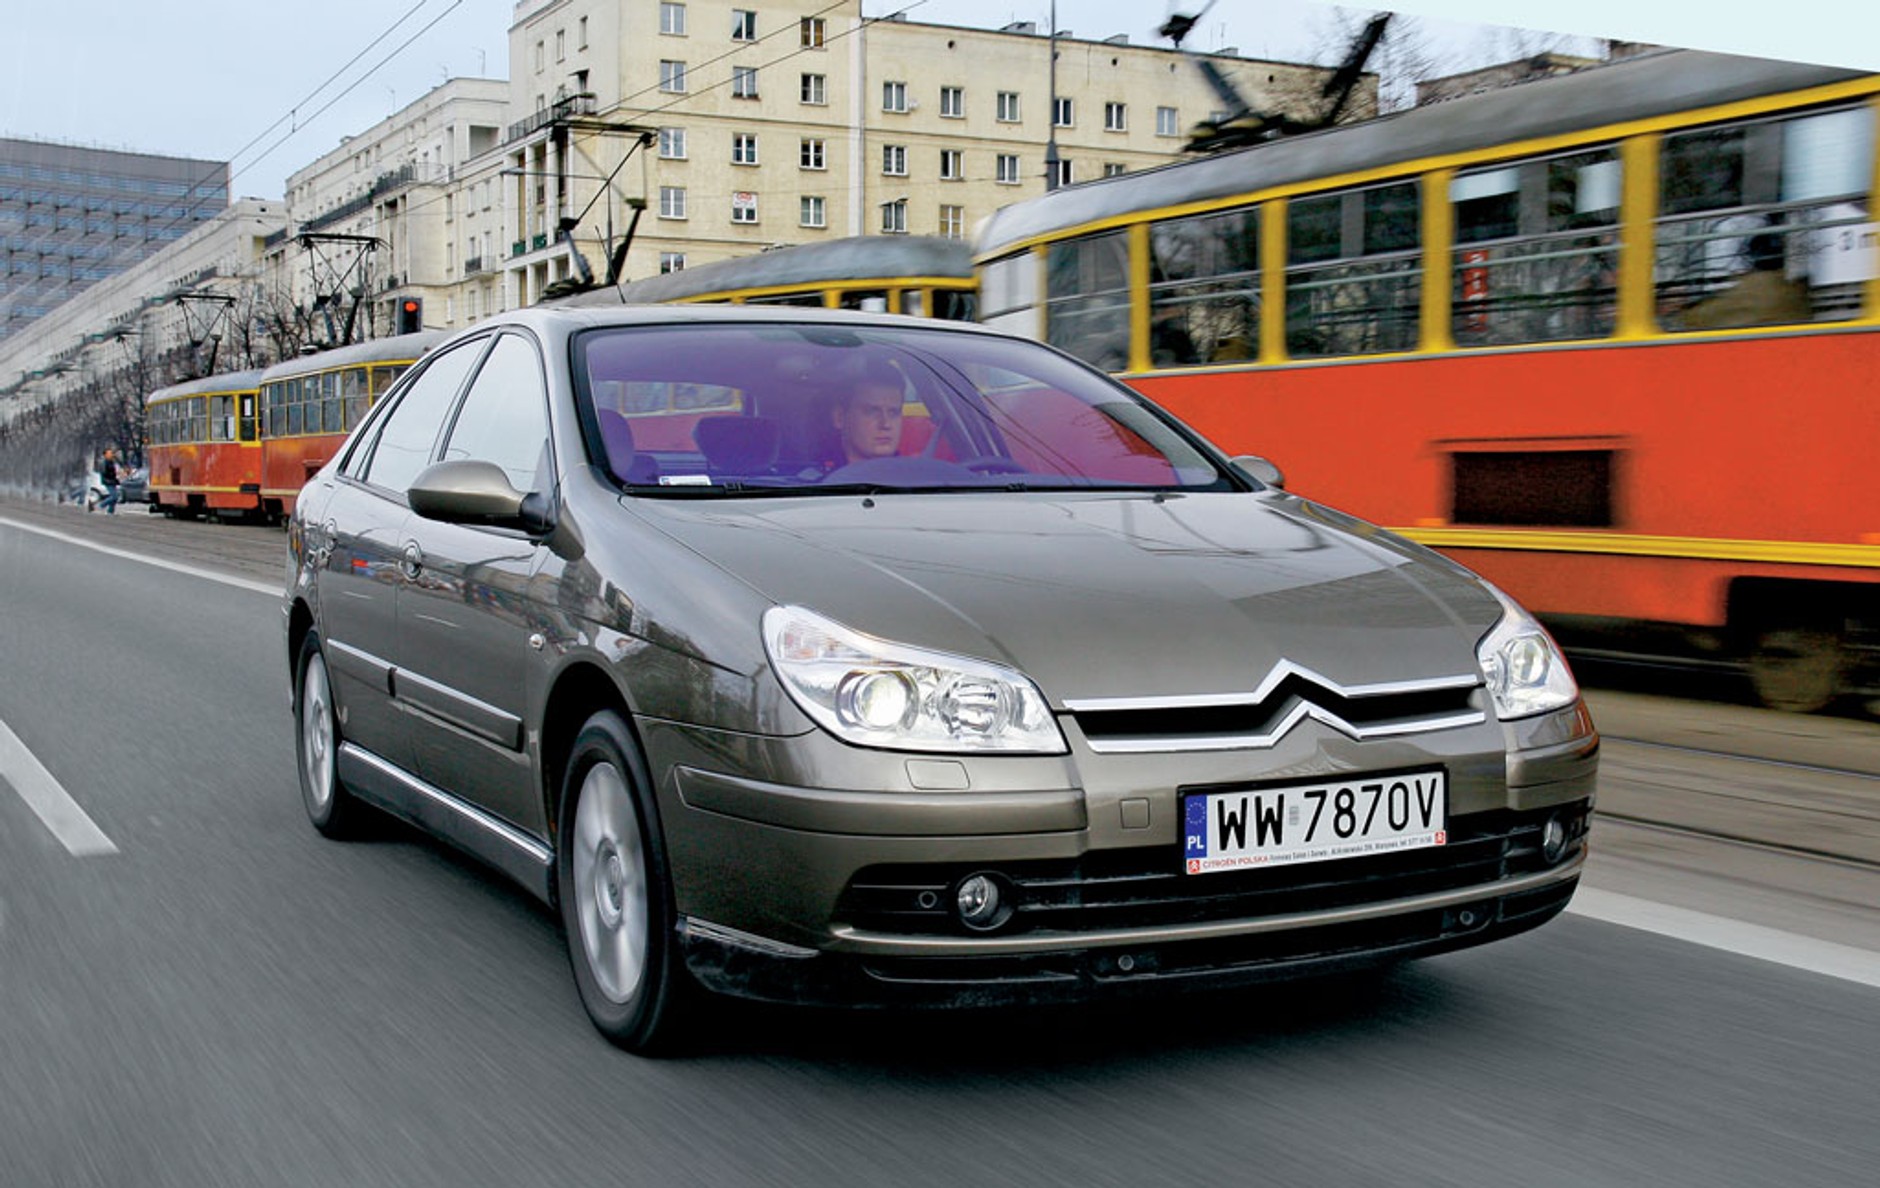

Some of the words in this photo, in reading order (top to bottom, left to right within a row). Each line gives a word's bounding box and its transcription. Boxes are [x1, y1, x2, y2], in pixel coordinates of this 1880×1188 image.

[1218, 794, 1284, 851] WW
[1304, 778, 1437, 842] 7870V
[1187, 835, 1204, 850] PL
[1238, 855, 1268, 866] POLSKA
